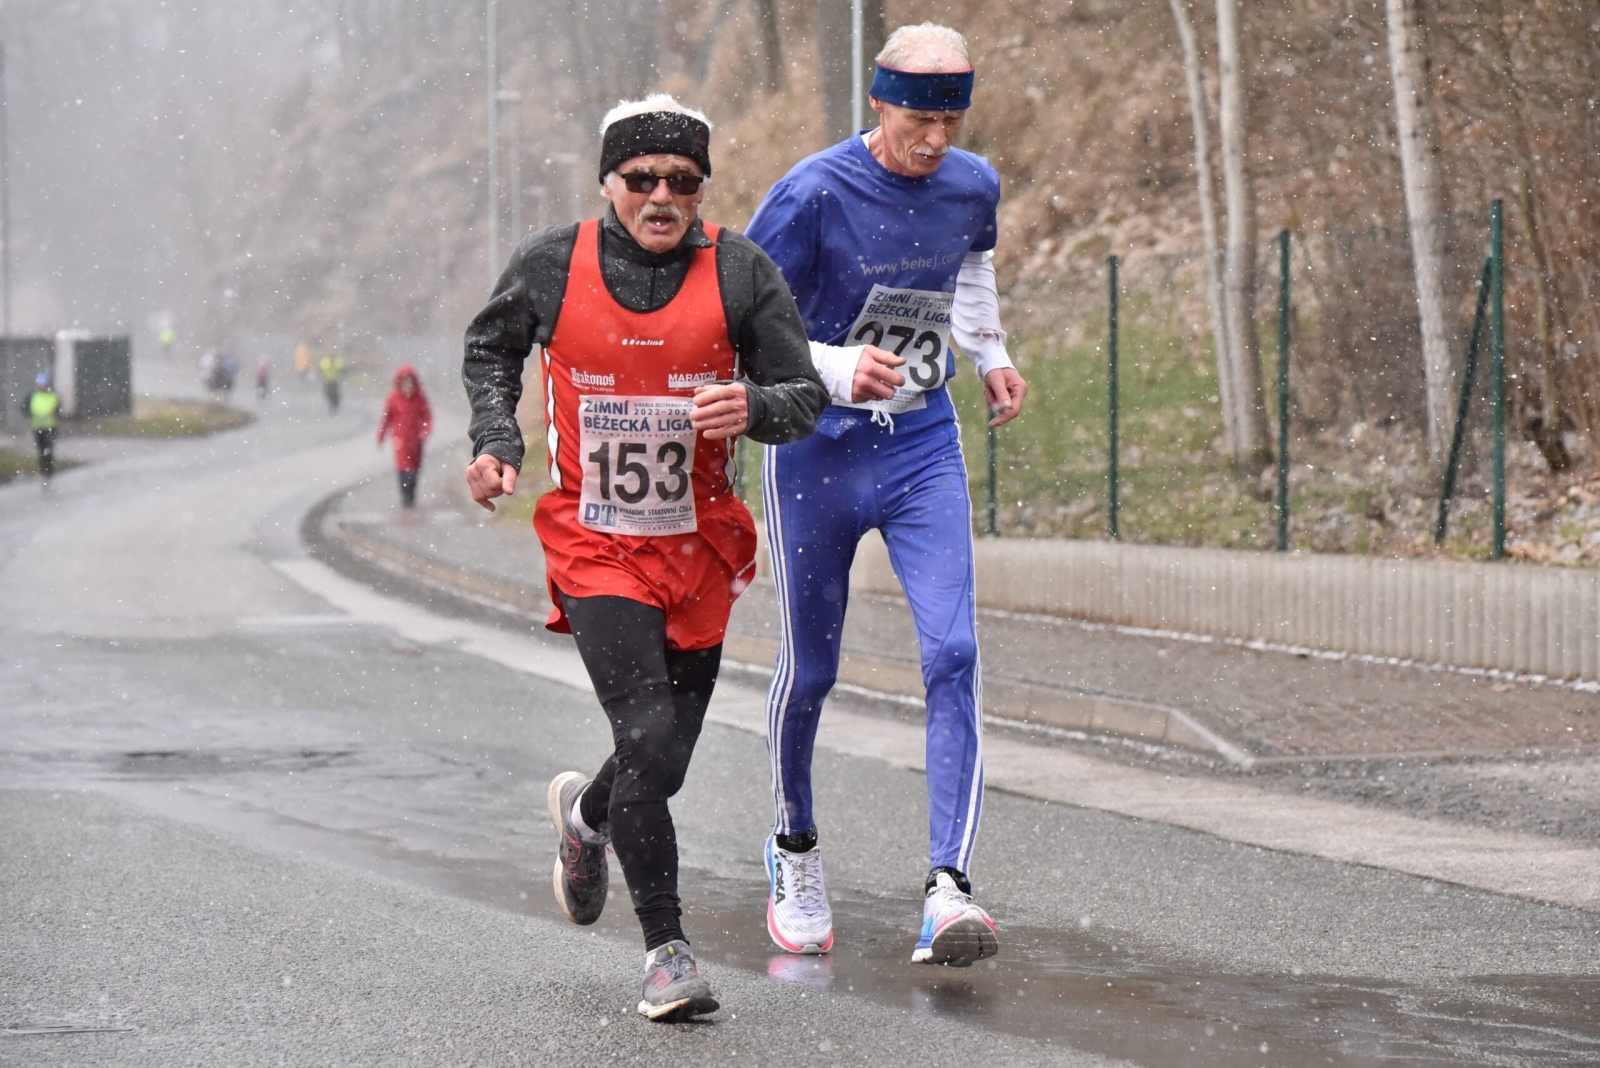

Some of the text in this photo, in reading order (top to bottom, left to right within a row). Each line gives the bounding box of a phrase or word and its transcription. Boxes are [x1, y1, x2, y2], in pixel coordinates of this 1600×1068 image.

[862, 252, 960, 275] www.behej.com
[873, 291, 913, 304] ZIMNÍ
[866, 302, 920, 319] BĚŽECKÁ
[923, 311, 951, 324] LIGA
[668, 370, 717, 382] MARATON
[584, 400, 629, 416] ZIMNÍ
[584, 415, 693, 432] BĚŽECKÁ LIGA
[589, 441, 688, 504] 153
